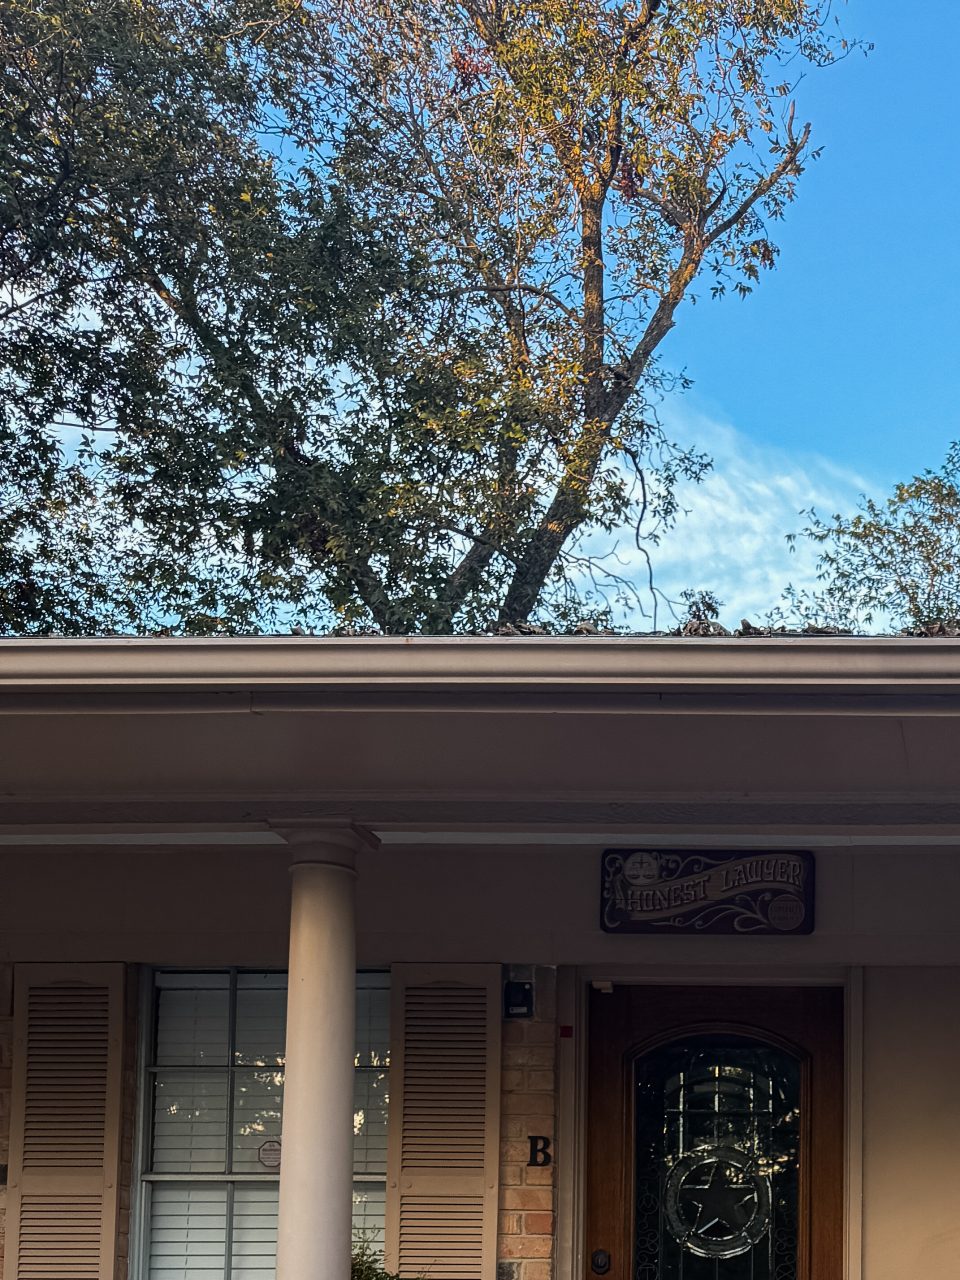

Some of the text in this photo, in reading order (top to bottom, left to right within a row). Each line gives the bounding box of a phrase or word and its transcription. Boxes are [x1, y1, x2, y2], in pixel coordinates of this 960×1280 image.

[627, 859, 802, 911] HONEST LAWYER
[526, 1135, 551, 1167] B
